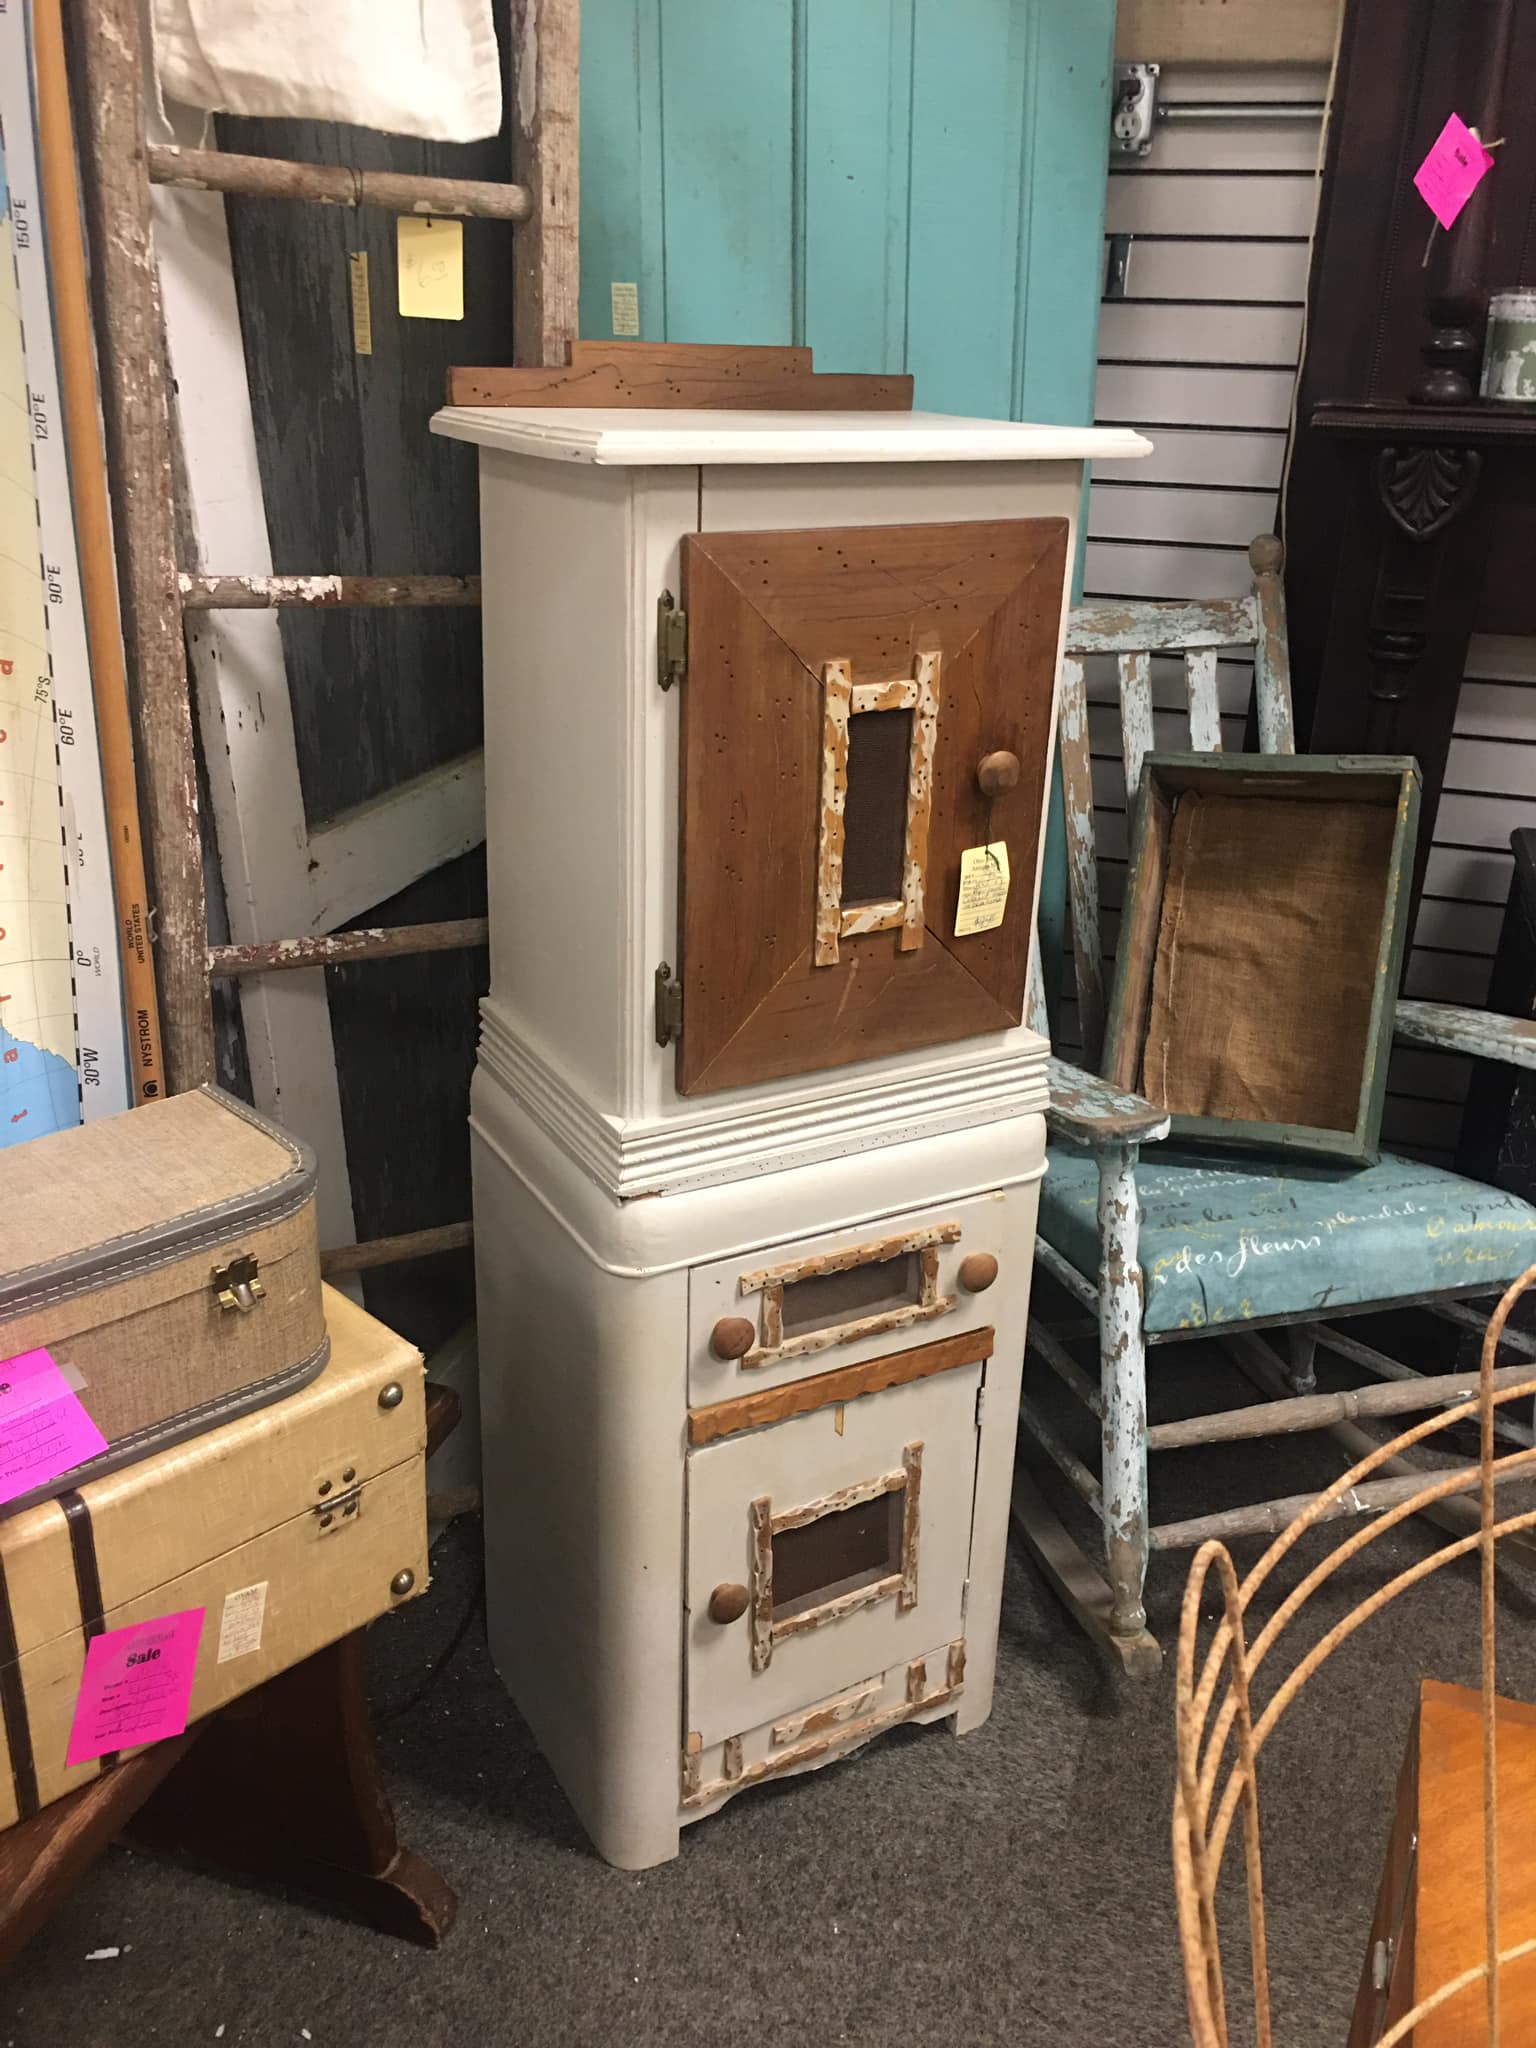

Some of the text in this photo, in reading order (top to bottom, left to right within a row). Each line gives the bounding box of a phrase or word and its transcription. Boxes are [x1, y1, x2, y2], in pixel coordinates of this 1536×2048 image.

[126, 918, 135, 949] WORLD
[132, 904, 144, 964] UNITED STATES
[138, 1009, 153, 1067] NYSTROM
[1175, 1245, 1224, 1274] des
[1226, 1234, 1322, 1278] fleurs
[126, 1648, 162, 1668] Sale
